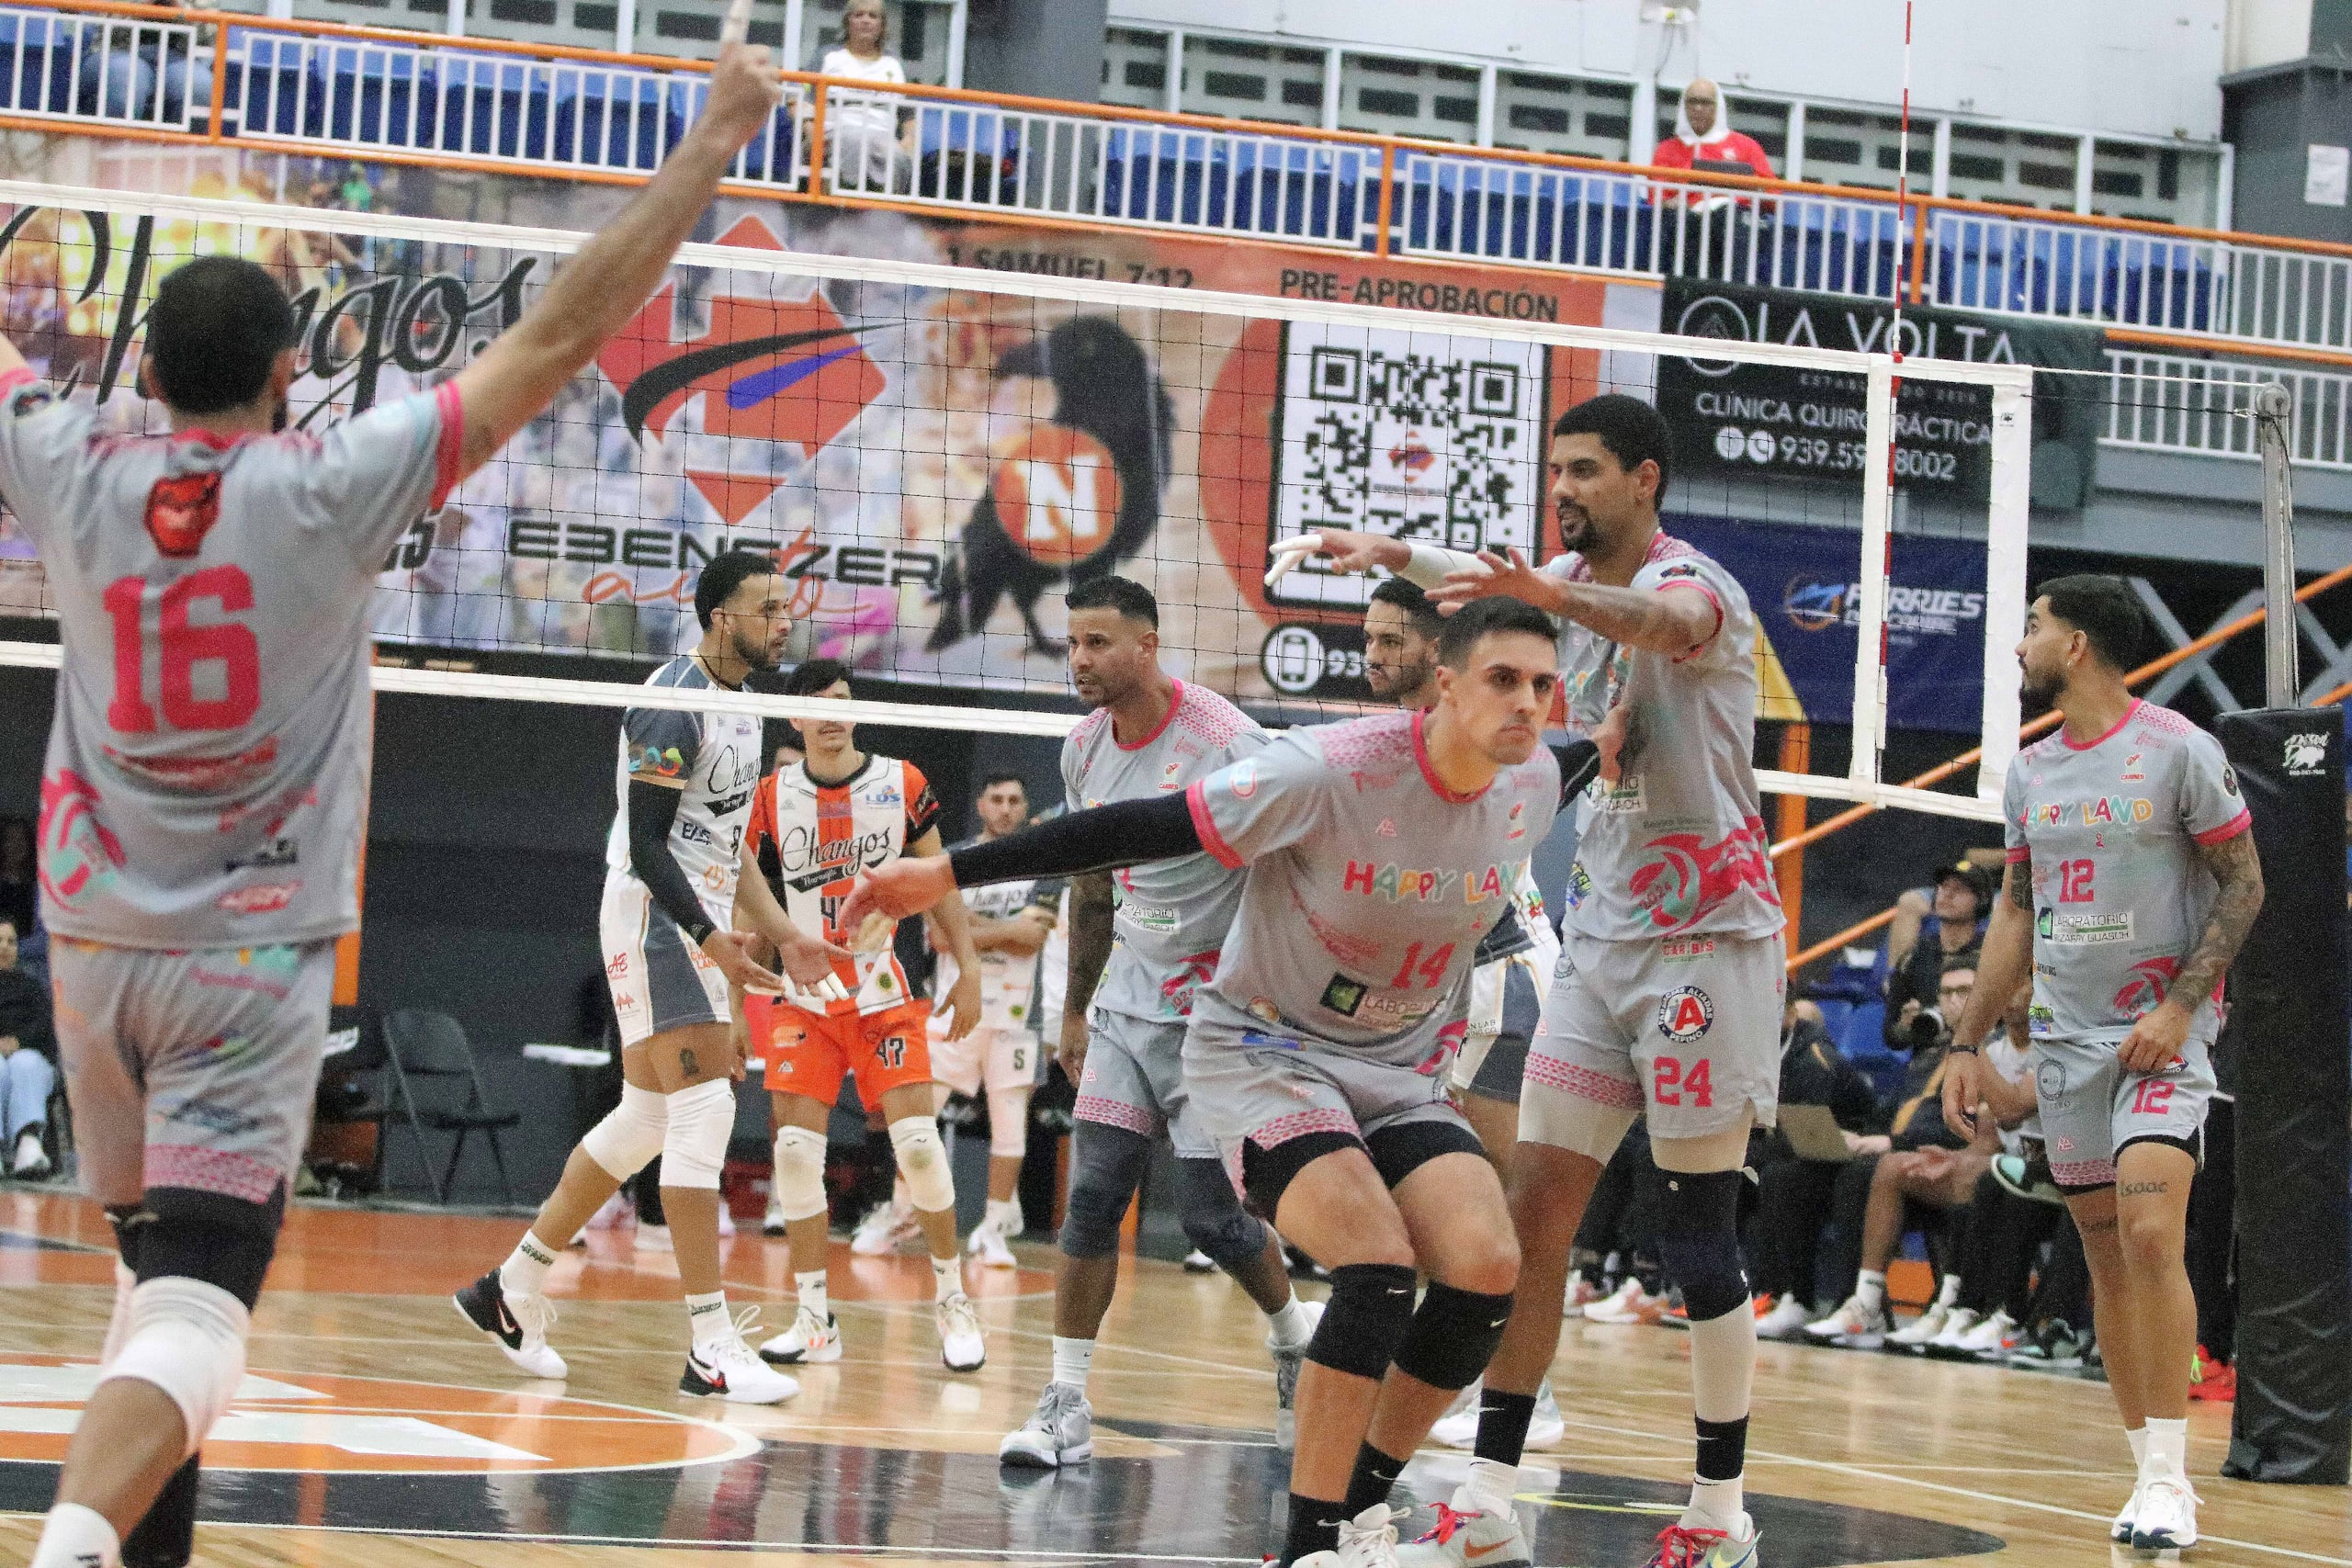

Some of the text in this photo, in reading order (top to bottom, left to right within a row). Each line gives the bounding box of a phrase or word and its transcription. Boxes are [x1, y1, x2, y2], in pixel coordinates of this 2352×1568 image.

[1280, 268, 1559, 321] PRE-APROBACIÓN
[1800, 402, 1992, 445] QUIRRÁCTICA
[1780, 434, 1957, 481] 939.598002
[1014, 454, 1100, 539] N
[103, 563, 261, 732] 16
[2081, 795, 2154, 826] LAND
[782, 826, 890, 876] Changos
[1343, 860, 1529, 905] HAPPY LAN
[2059, 858, 2095, 904] 12
[2053, 912, 2129, 929] LABORATORIO
[1390, 942, 1456, 989] 14
[1674, 996, 1707, 1032] A
[1654, 1056, 1713, 1108] 24
[2131, 1078, 2177, 1115] 12
